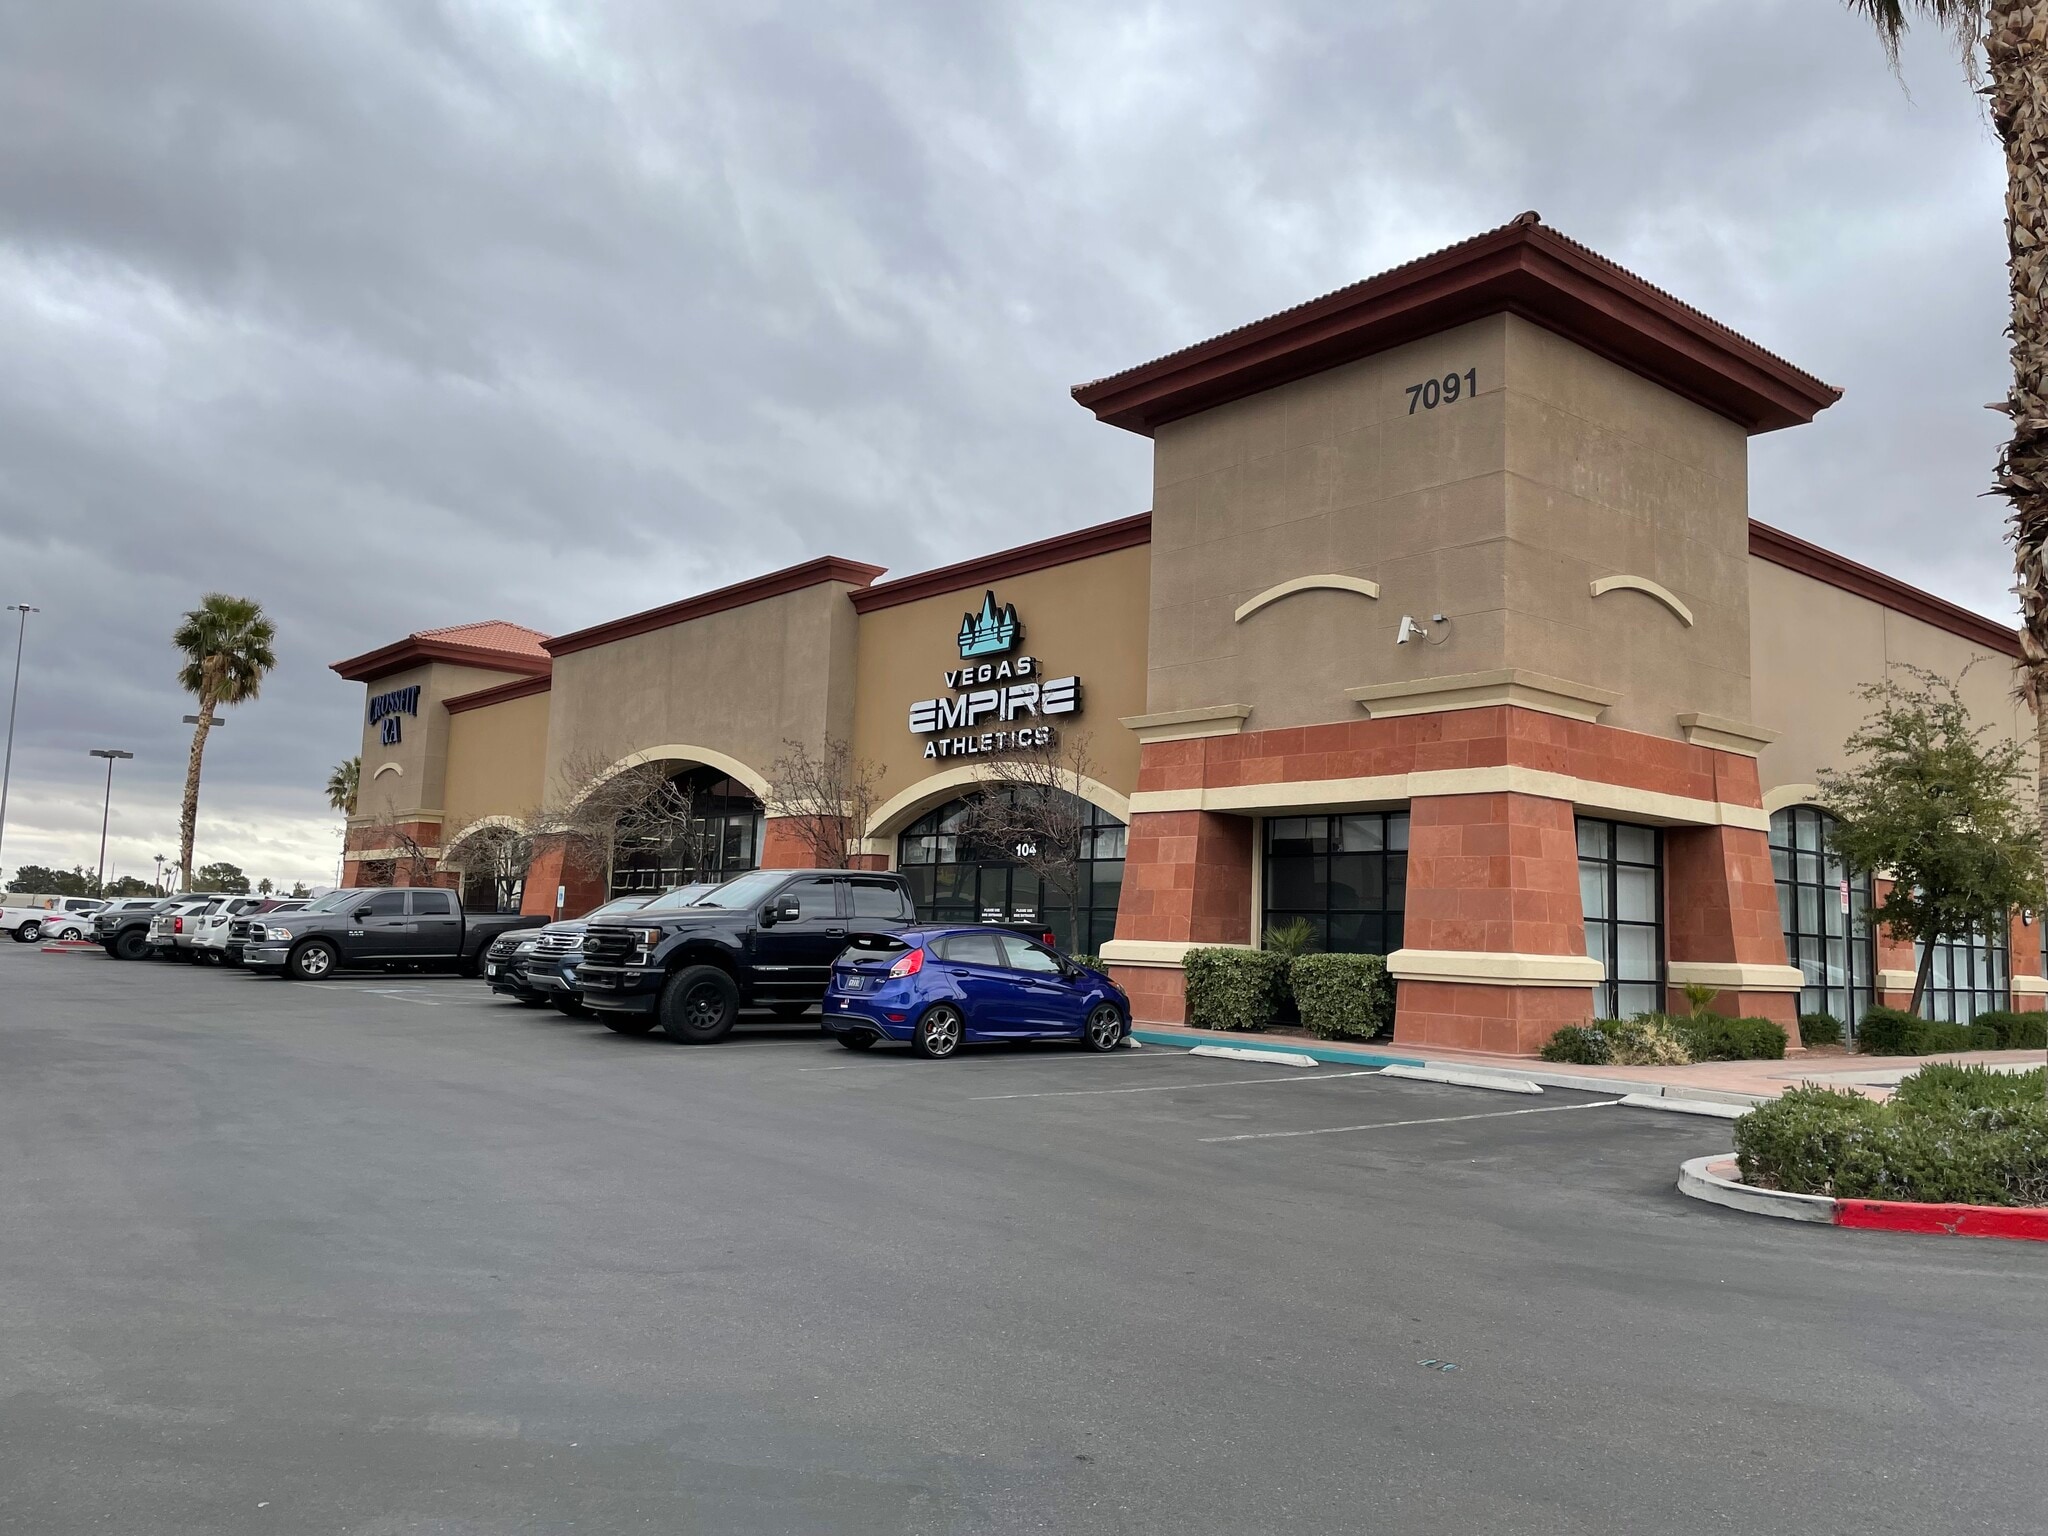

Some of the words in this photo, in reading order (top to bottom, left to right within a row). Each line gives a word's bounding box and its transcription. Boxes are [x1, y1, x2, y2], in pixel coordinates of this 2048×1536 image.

[1405, 367, 1476, 416] 7091
[944, 656, 1034, 690] VEGAS
[368, 685, 421, 726] CROSSFIT
[908, 676, 1079, 734] EMPIRE
[923, 726, 1053, 759] ATHLETICS
[1015, 843, 1037, 857] 104
